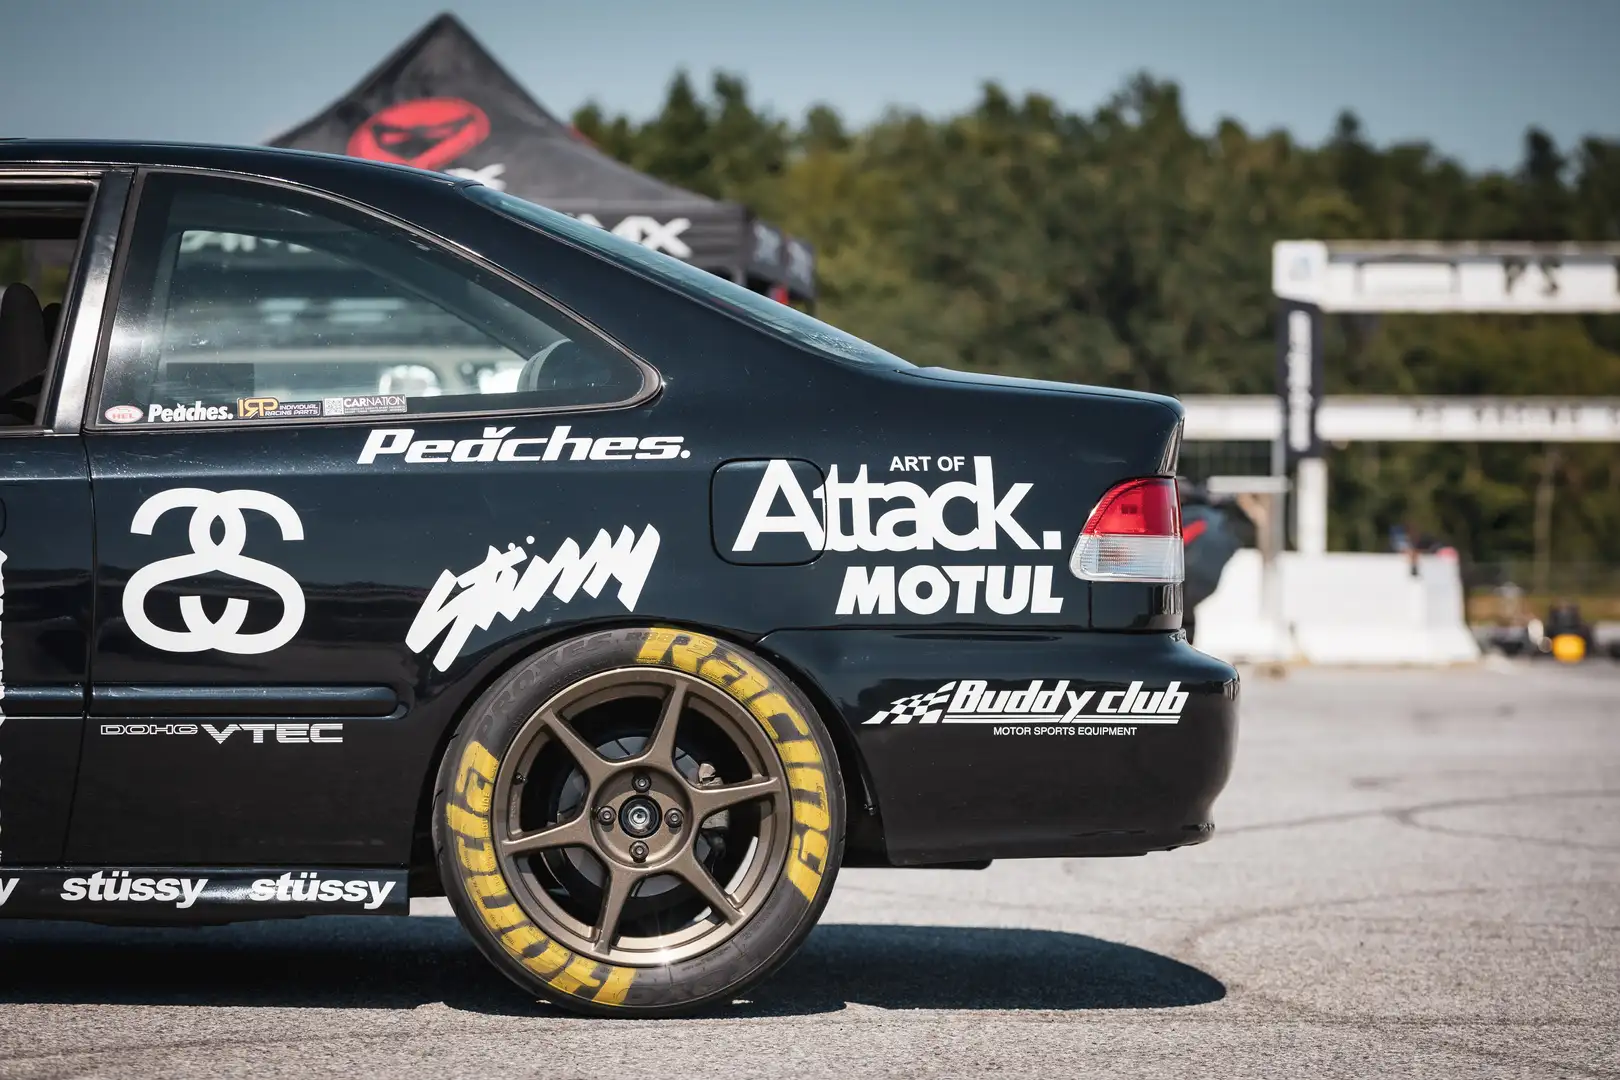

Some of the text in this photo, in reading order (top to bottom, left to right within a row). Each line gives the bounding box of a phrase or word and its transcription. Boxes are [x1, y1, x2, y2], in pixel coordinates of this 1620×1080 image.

[265, 409, 293, 417] RACING
[343, 395, 405, 407] CARNATION
[889, 455, 966, 472] ART OF
[731, 455, 1063, 552] Attack.
[834, 564, 1065, 616] MOTUL
[947, 679, 1190, 724] Buddy club
[100, 723, 344, 744] DOHC VTEC
[993, 726, 1138, 737] MOTOR SPORTS EQUIPMENT
[636, 627, 831, 902] Racing
[61, 870, 209, 909] stüssy
[250, 871, 397, 910] stüssy
